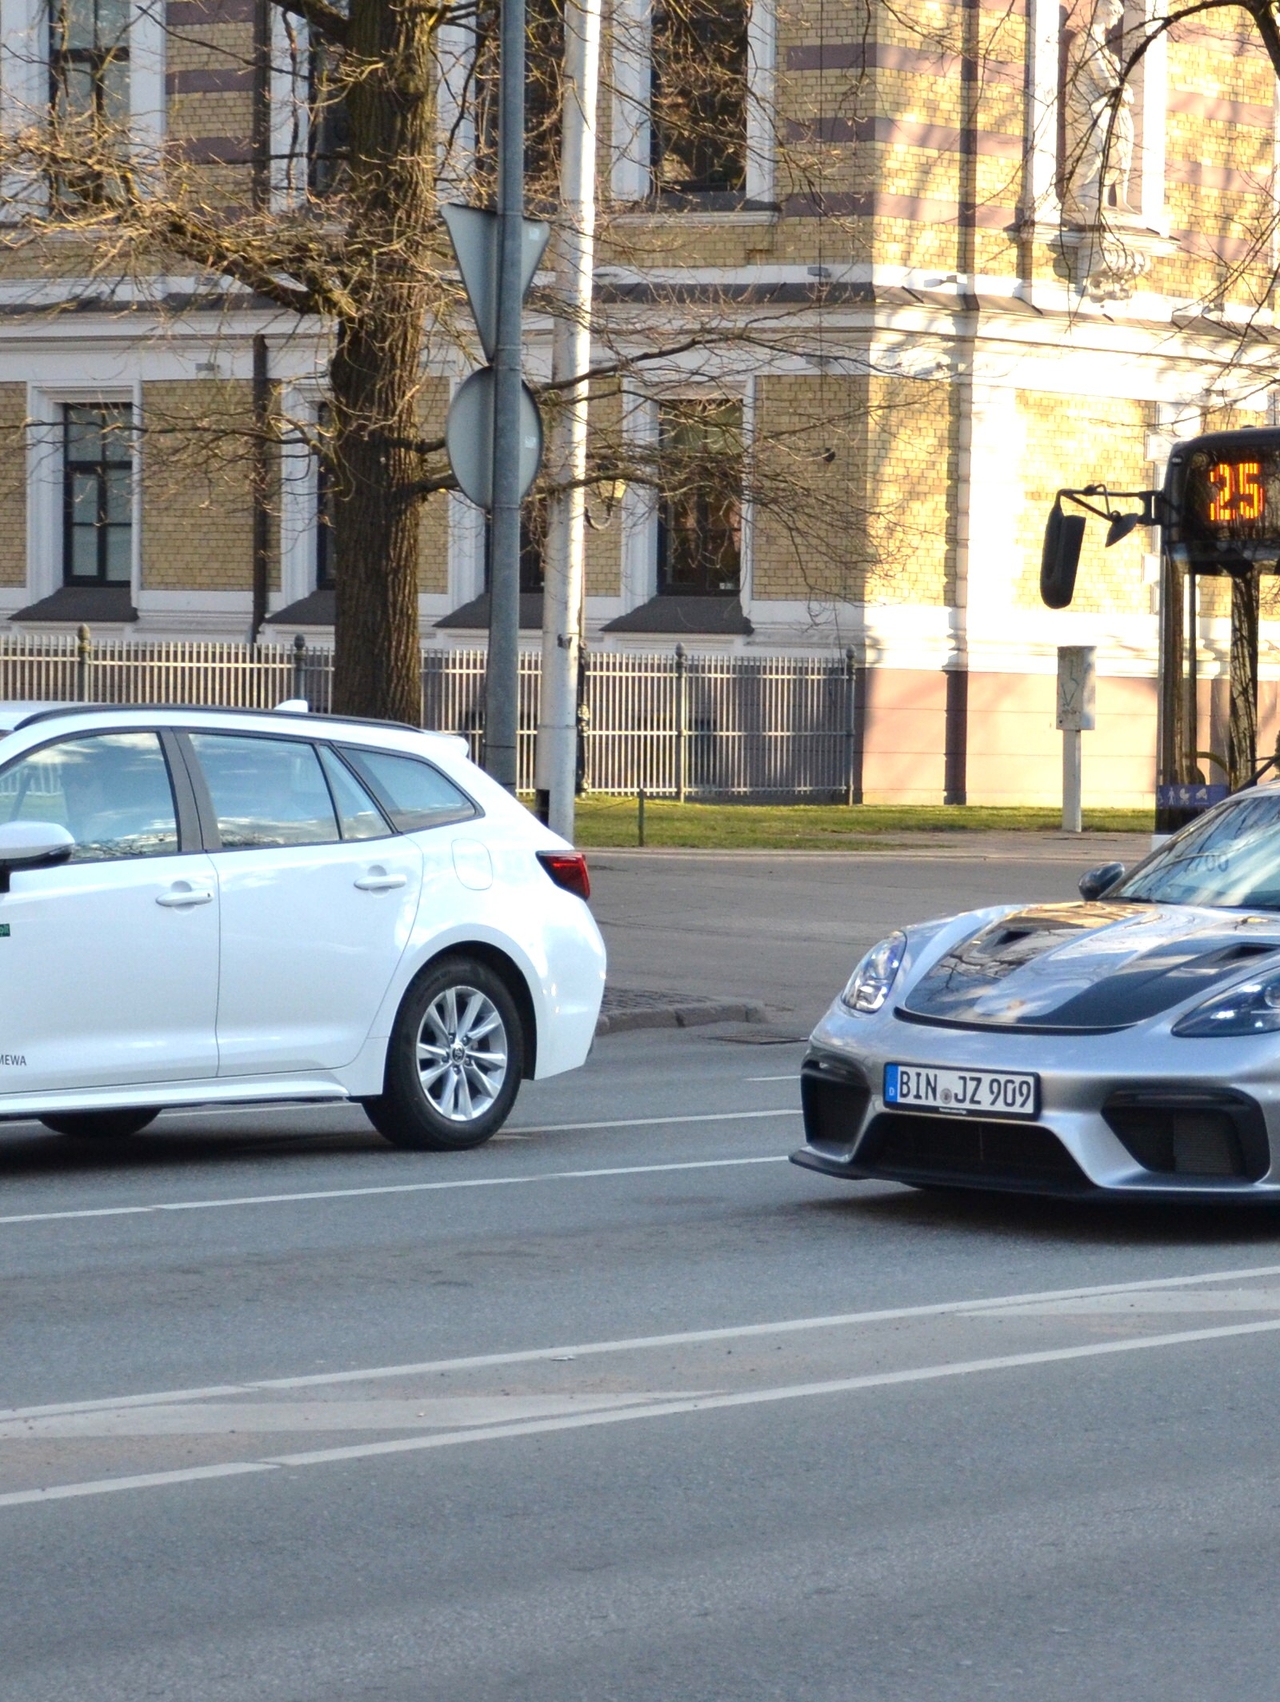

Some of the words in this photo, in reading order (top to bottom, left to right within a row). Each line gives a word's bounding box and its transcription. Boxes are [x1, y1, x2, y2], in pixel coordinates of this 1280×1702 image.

[1210, 463, 1263, 521] 25
[889, 1087, 895, 1096] D
[900, 1070, 938, 1102] BIN
[954, 1076, 982, 1105] JZ
[989, 1078, 1032, 1109] 909
